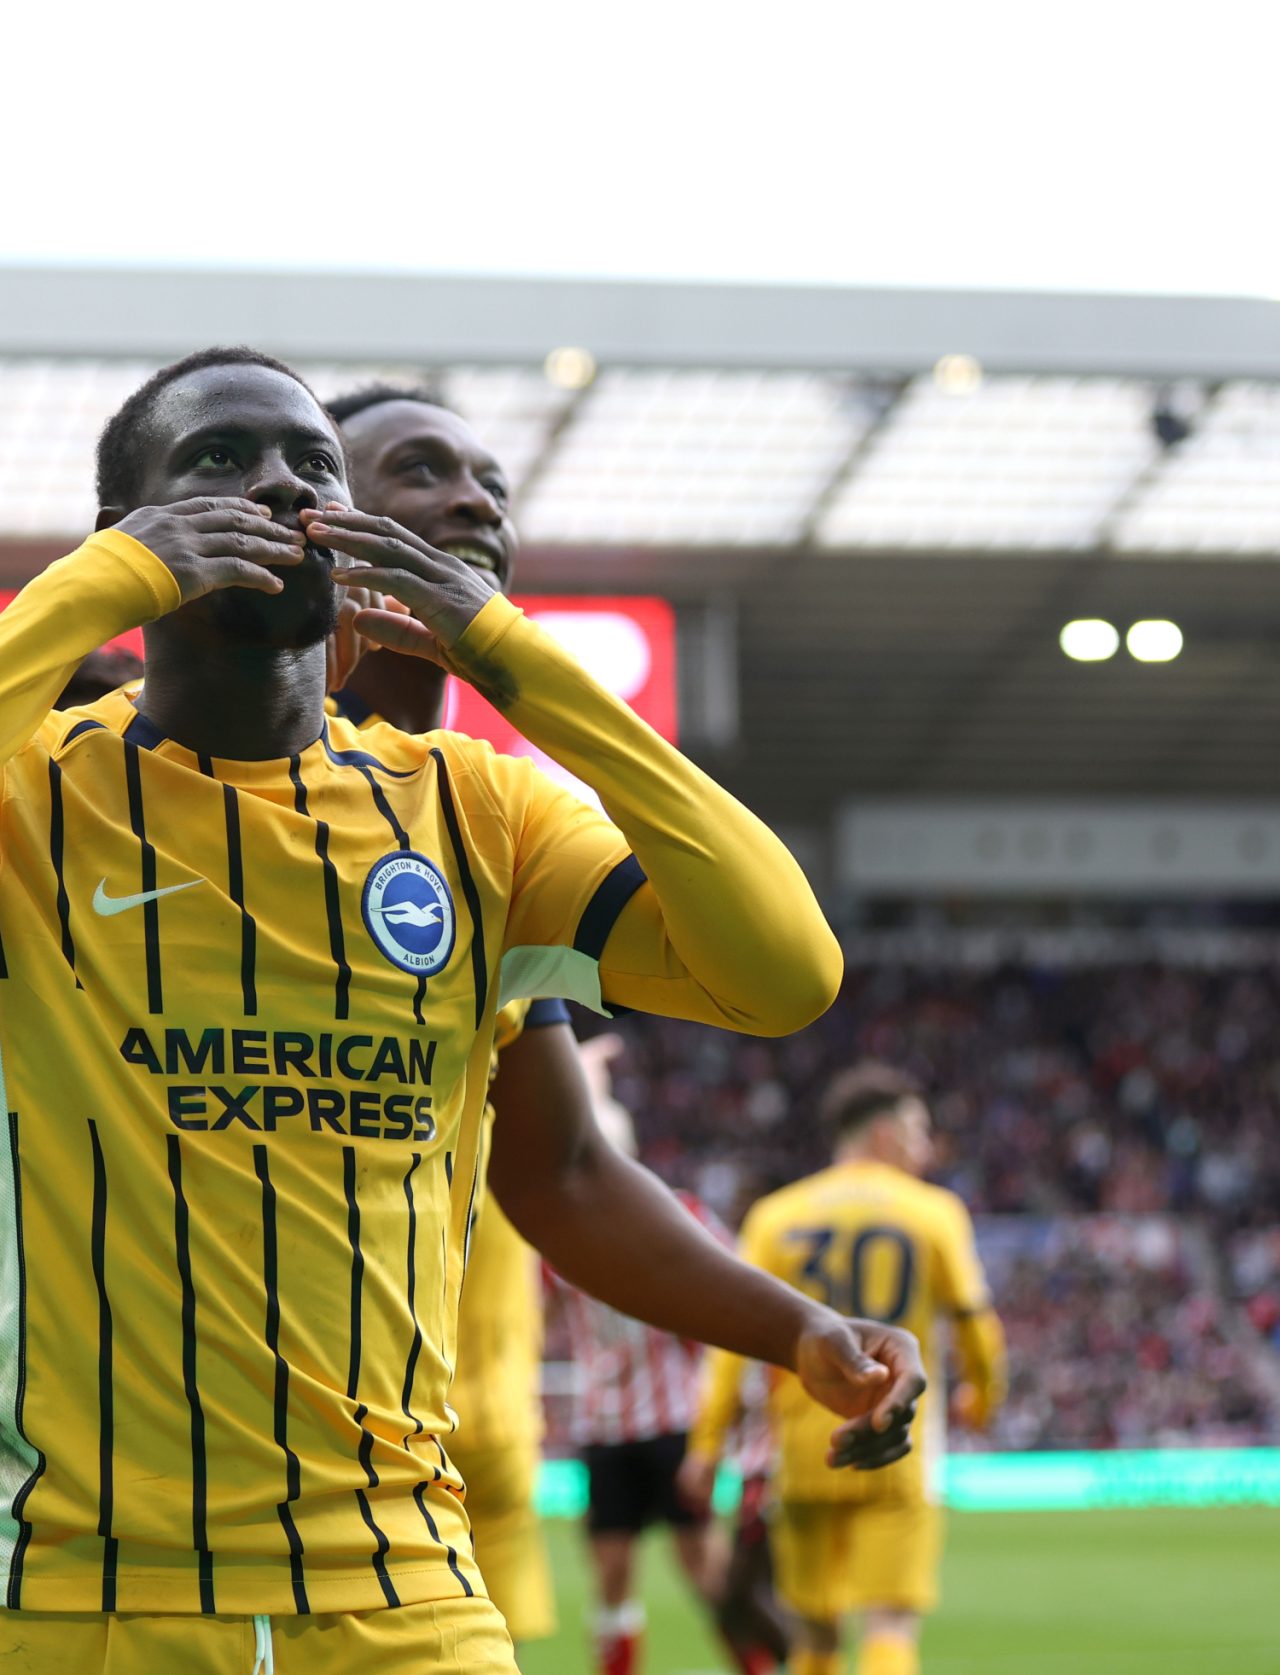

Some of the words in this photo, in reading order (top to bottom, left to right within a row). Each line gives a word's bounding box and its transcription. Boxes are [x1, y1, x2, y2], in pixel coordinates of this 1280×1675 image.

[375, 862, 412, 890] BRIGHTON
[415, 864, 421, 873] &
[424, 870, 443, 893] HOVE
[403, 953, 435, 966] ALBION
[120, 1028, 437, 1085] AMERICAN
[167, 1086, 436, 1141] EXPRESS
[783, 1226, 915, 1324] 30
